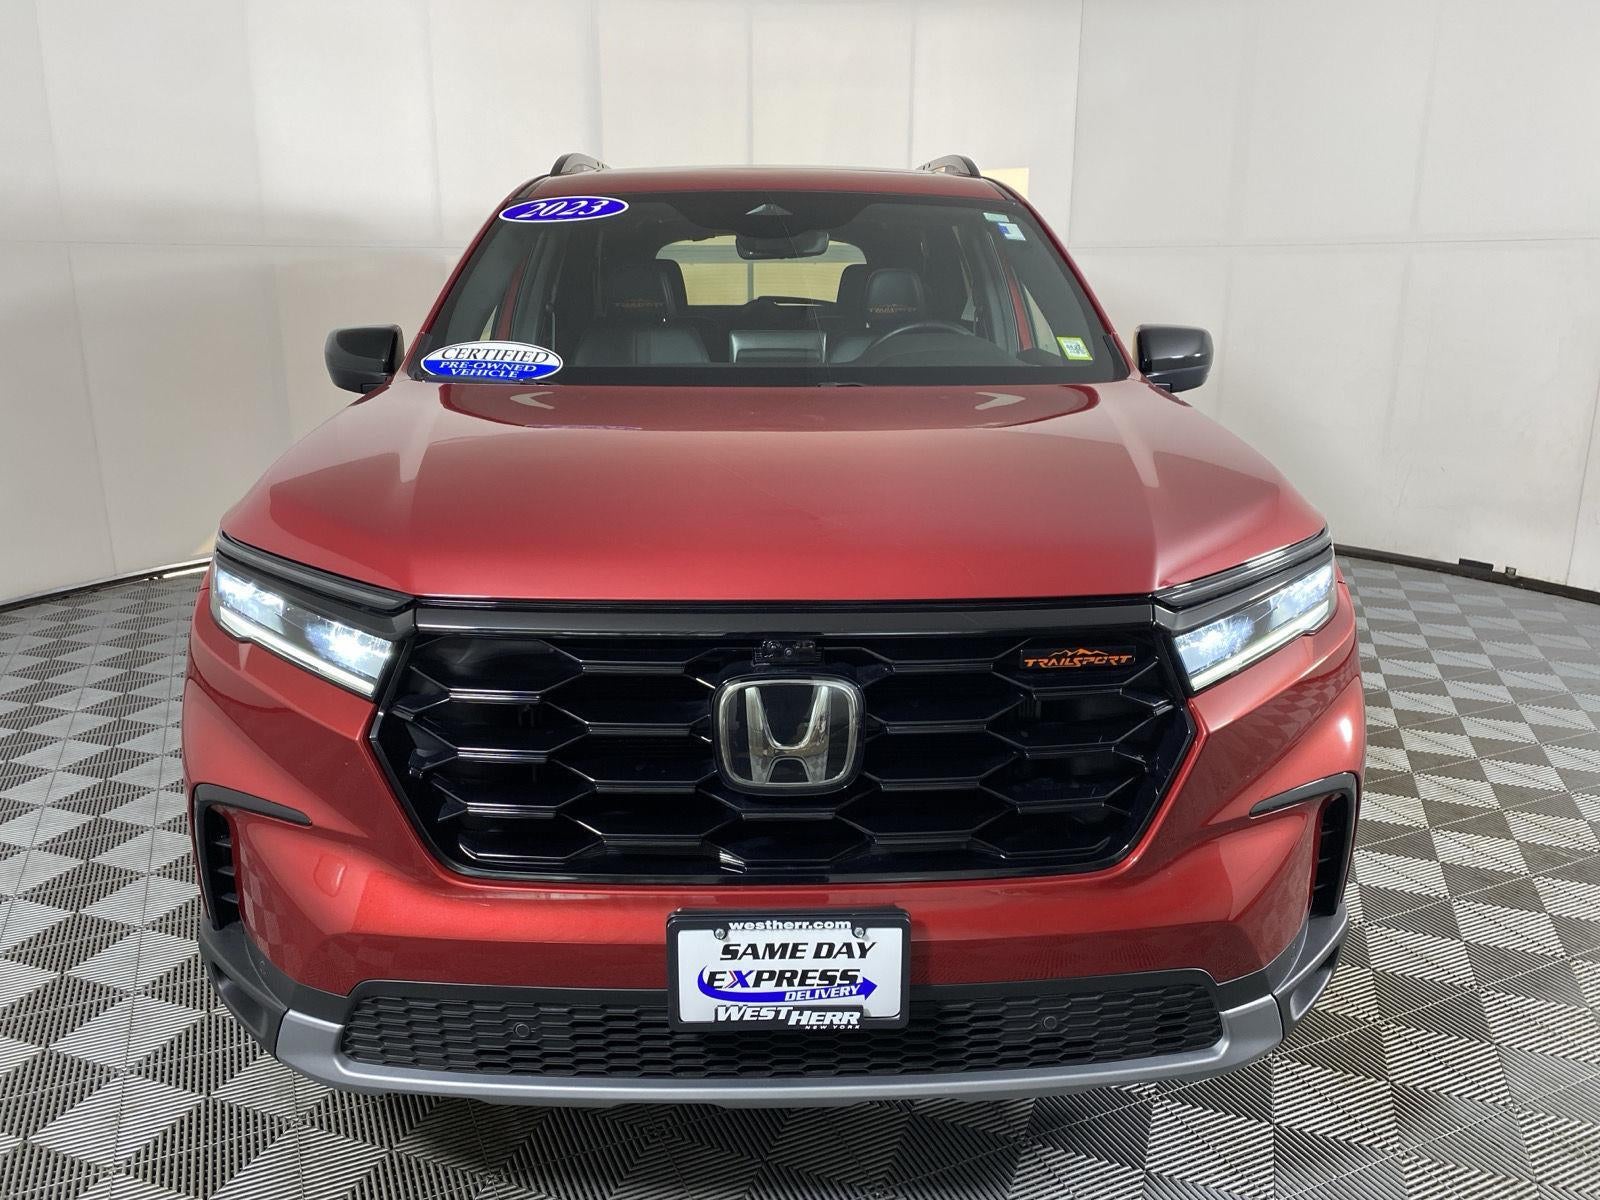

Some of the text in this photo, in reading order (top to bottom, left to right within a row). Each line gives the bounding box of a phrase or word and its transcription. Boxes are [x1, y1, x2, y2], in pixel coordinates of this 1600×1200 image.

[515, 200, 610, 219] 2023
[441, 347, 550, 364] CERTIFIED
[439, 361, 537, 372] PRE-OWNED
[451, 368, 519, 378] VEHICLE
[1024, 655, 1133, 668] TRAILSPORT
[728, 920, 852, 931] westherr.com
[719, 941, 878, 961] SAME DAY
[706, 968, 861, 989] EXPRESS
[784, 984, 861, 1002] DELIVERY
